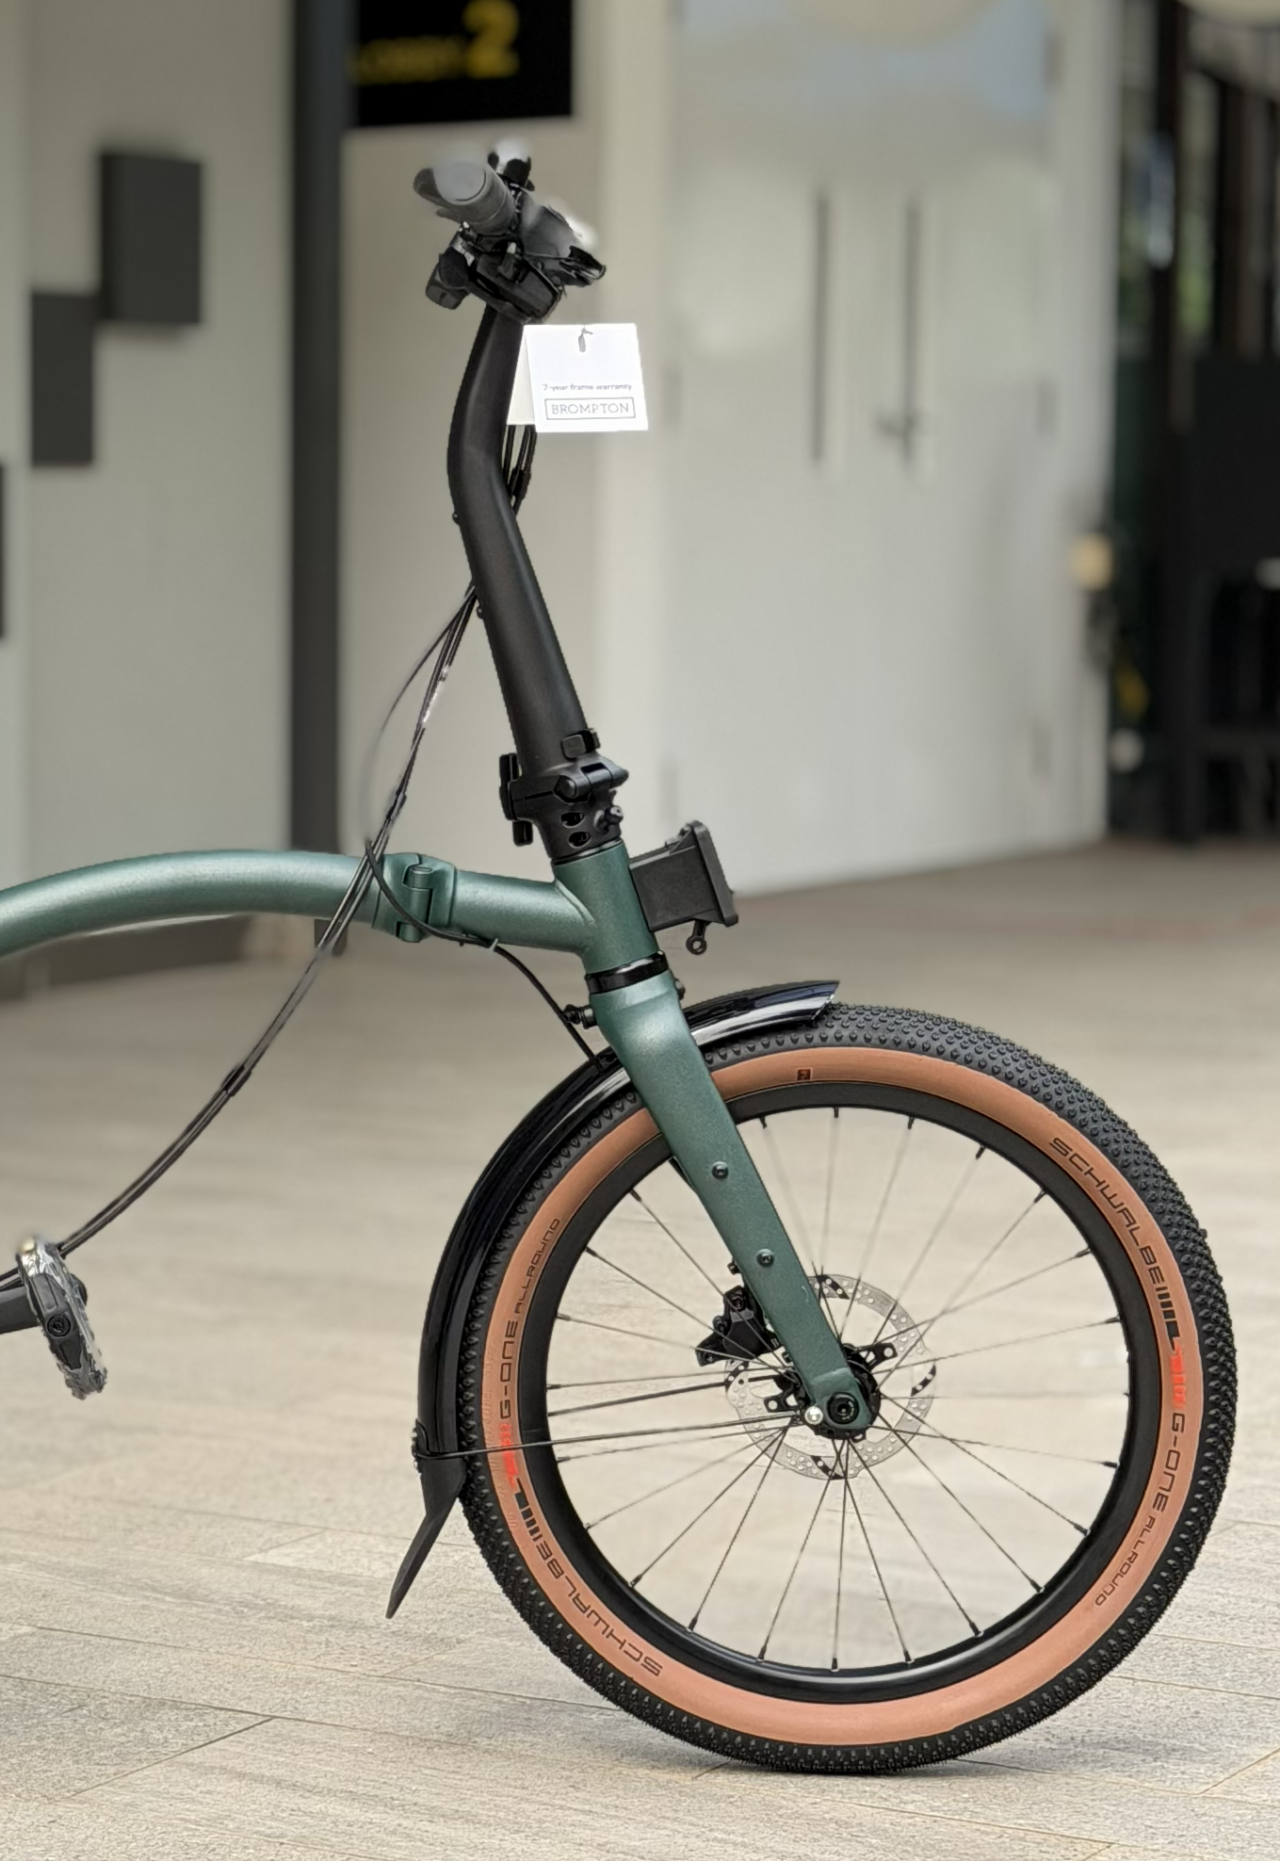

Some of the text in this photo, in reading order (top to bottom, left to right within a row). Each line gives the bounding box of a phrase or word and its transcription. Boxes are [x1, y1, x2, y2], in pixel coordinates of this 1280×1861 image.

[462, 0, 519, 78] 2
[542, 383, 632, 391] 7-year frame warranty
[551, 402, 629, 415] BROMPTON
[1049, 1137, 1186, 1607] SCHWALBE G-ONE ALLROUND
[499, 1218, 664, 1677] SCHWALBE G-ONE ALLROUND
